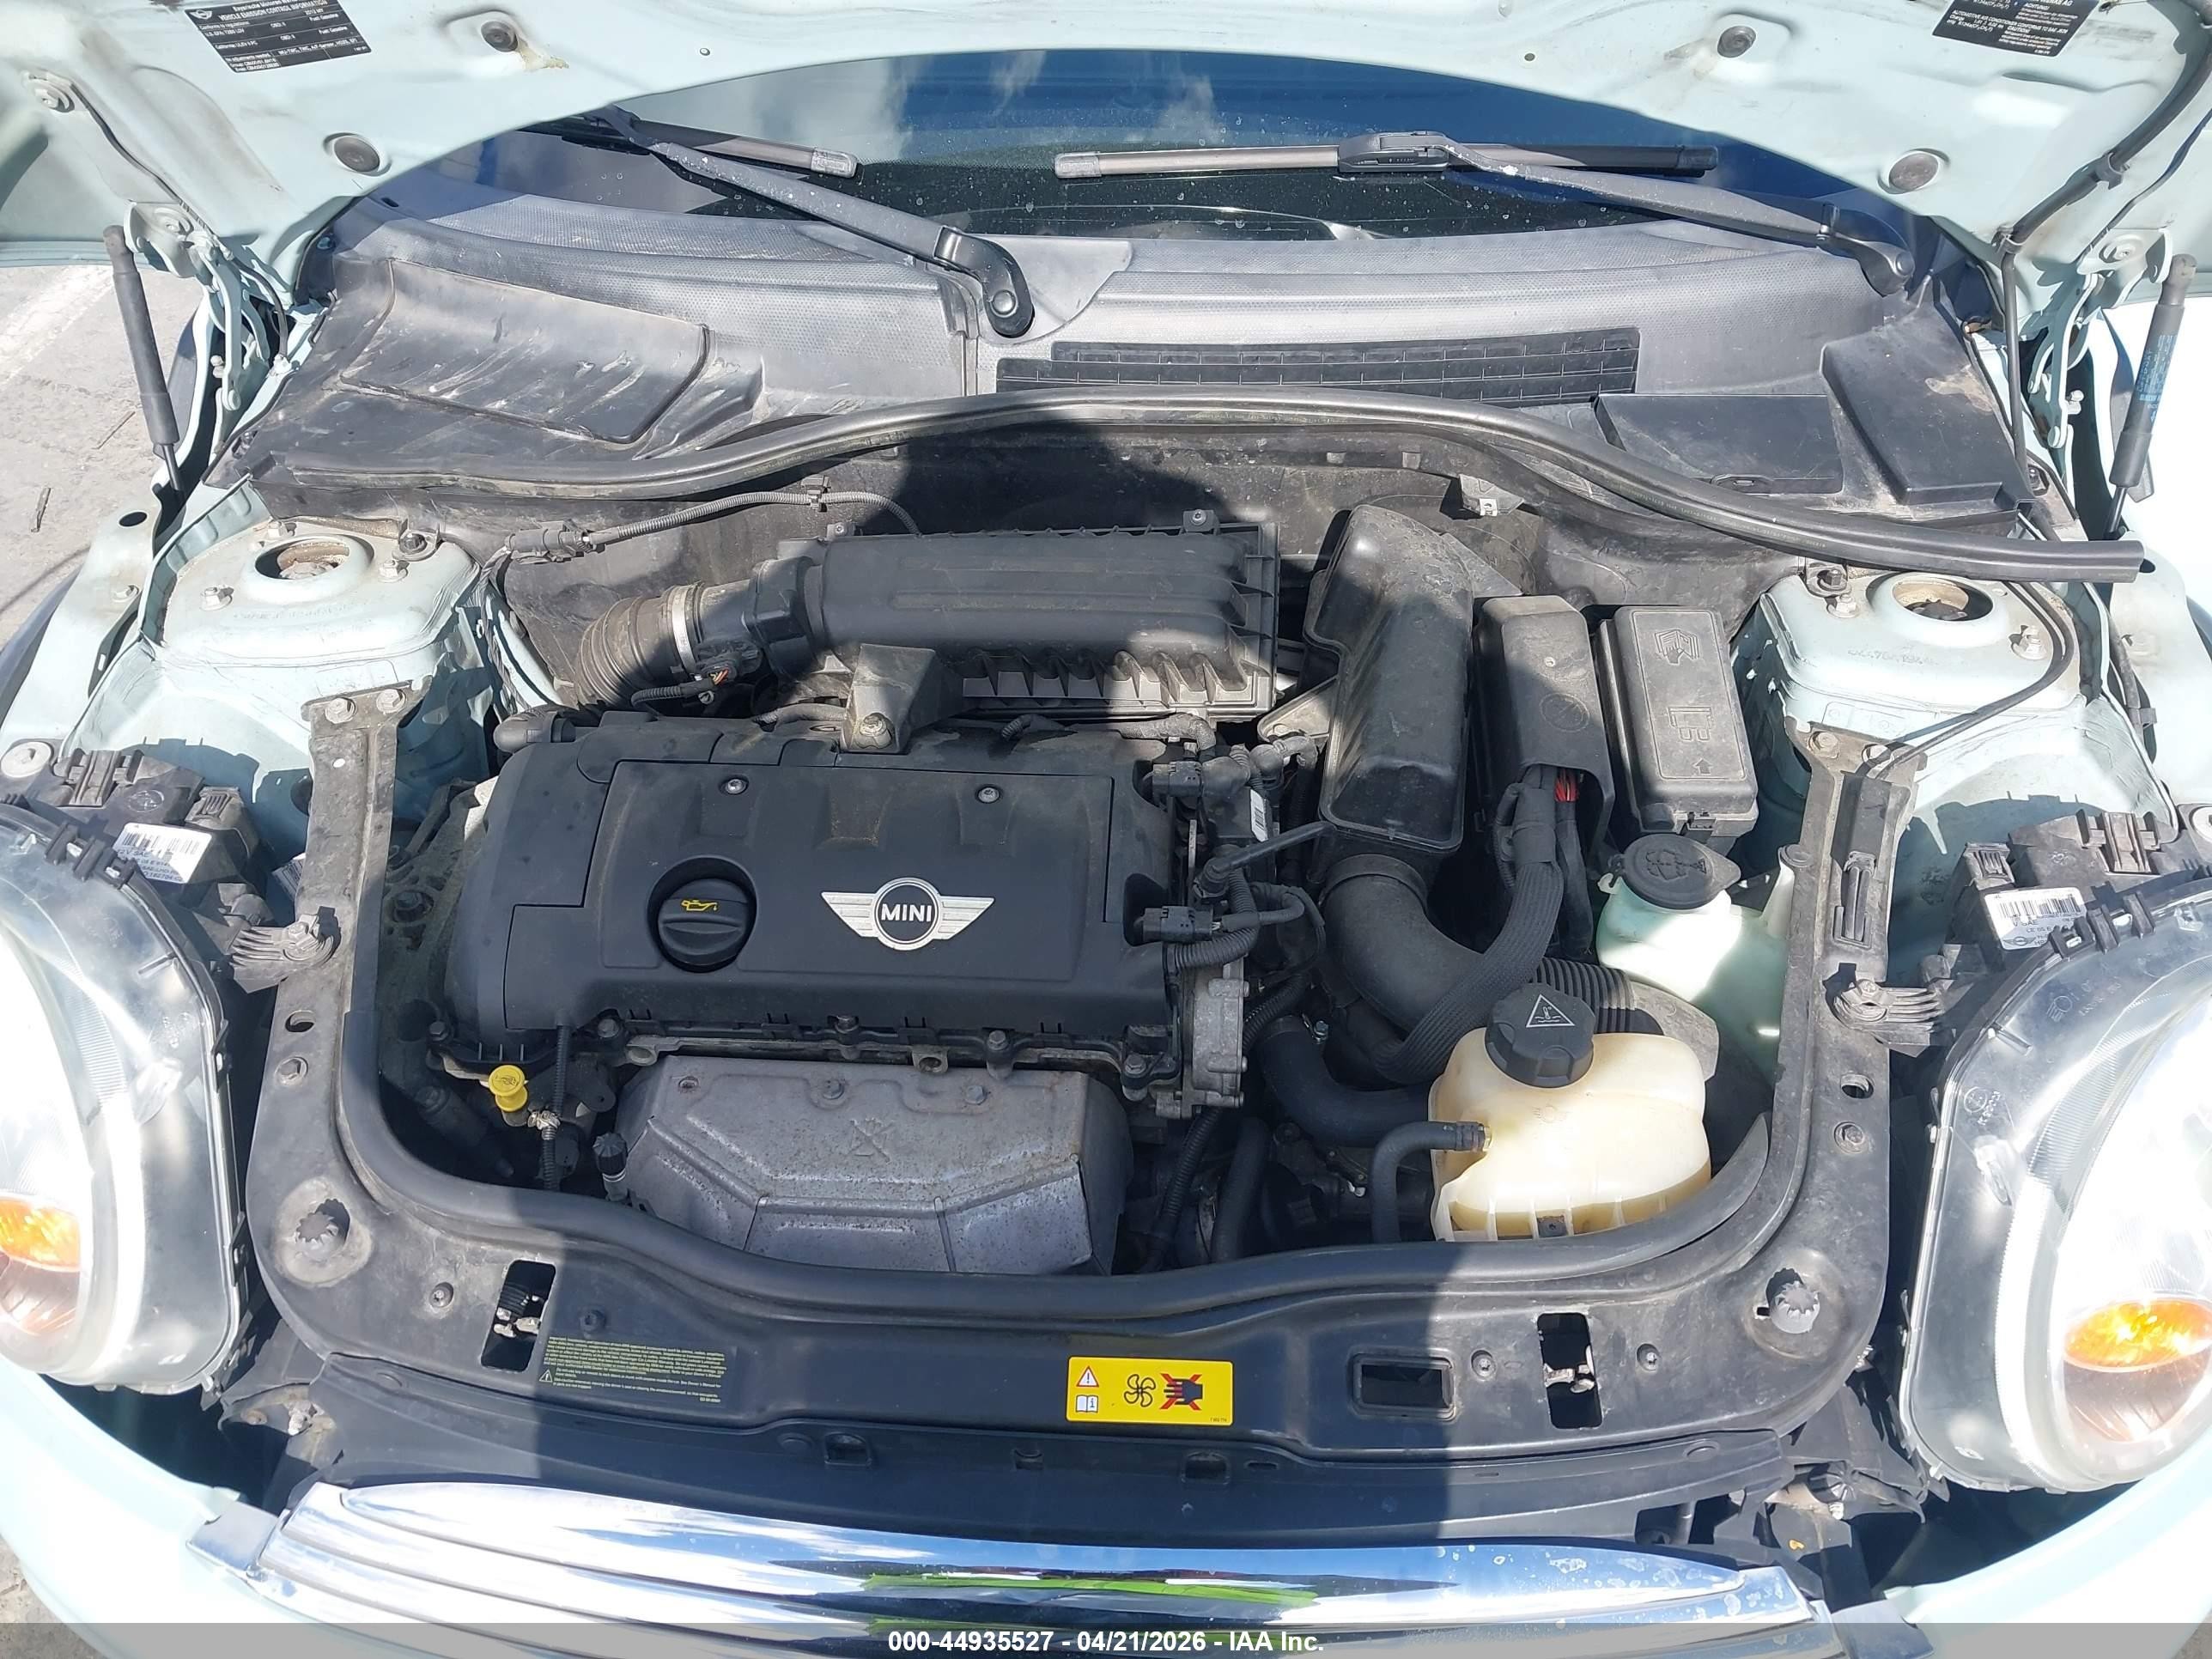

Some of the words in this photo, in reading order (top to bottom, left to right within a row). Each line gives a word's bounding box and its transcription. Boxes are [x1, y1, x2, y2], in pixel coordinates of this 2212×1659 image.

[218, 12, 241, 21] VEHICLE
[240, 9, 267, 19] EMISSION
[266, 5, 292, 14] CONTROL
[881, 903, 933, 922] MINI
